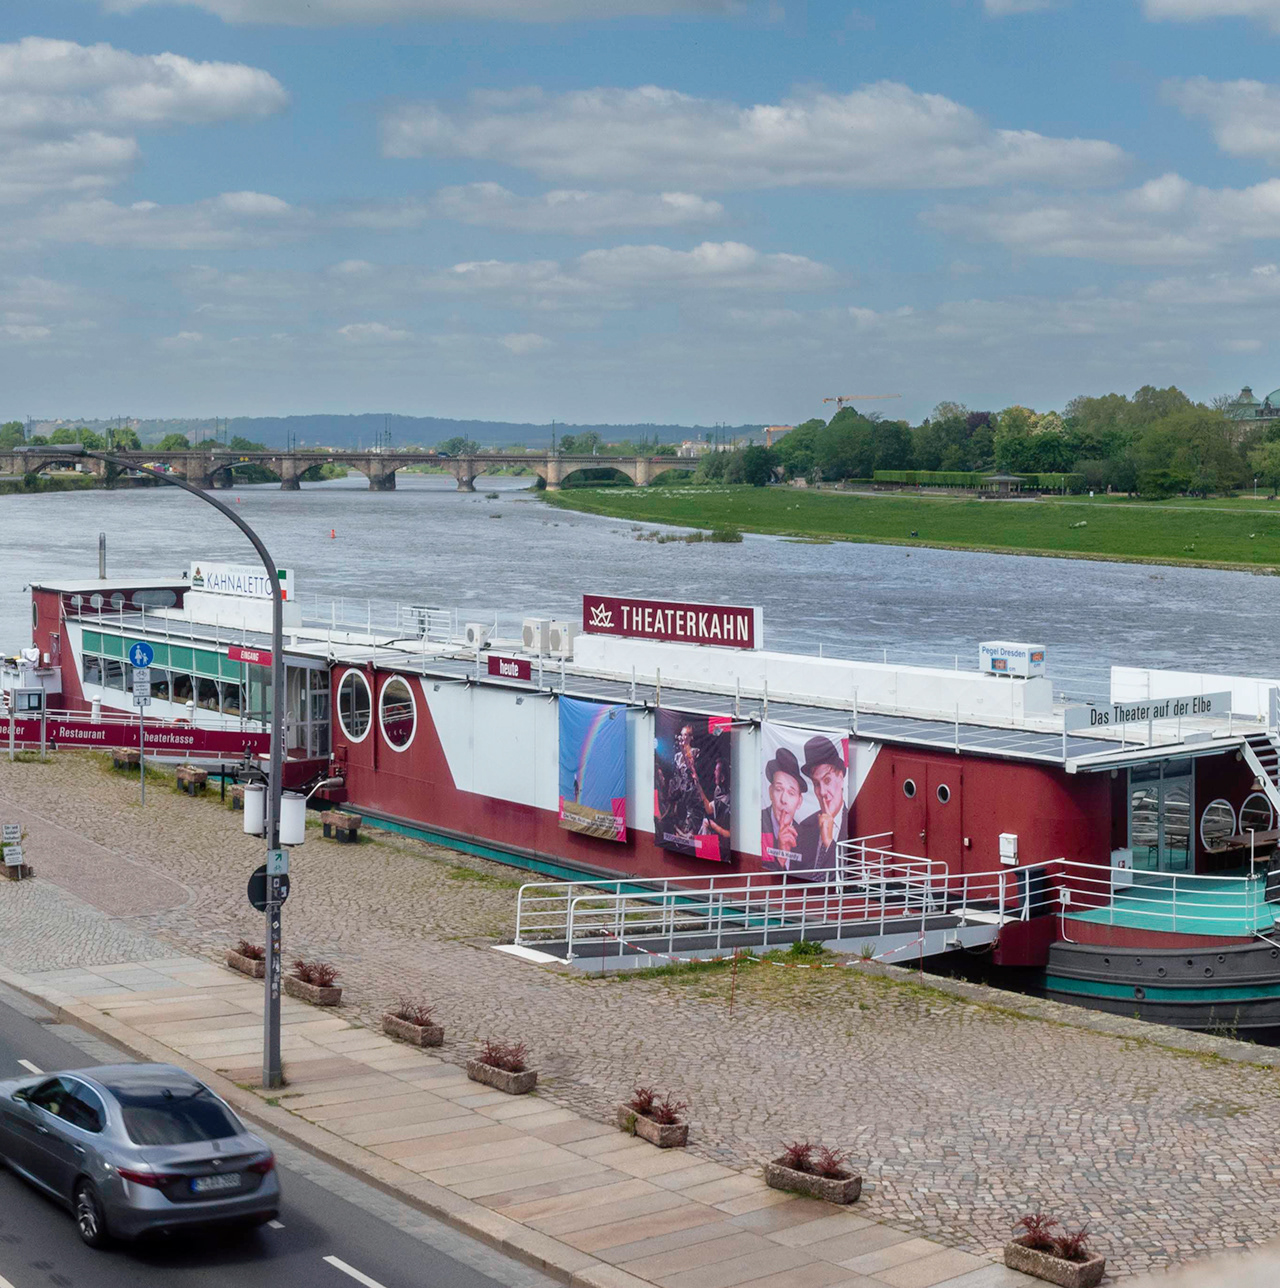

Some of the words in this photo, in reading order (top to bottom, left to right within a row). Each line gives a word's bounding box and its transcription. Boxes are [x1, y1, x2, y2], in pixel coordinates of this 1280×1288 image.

[621, 606, 749, 641] THEATERKAHN
[241, 650, 259, 661] EINGANG
[982, 646, 999, 656] Pegel
[1001, 648, 1026, 657] Dresden
[500, 659, 519, 676] heute
[1090, 708, 1109, 726] Das
[1114, 703, 1150, 722] Theater
[1153, 700, 1170, 718] auf
[1173, 699, 1189, 716] der
[1192, 697, 1211, 714] Elbe
[59, 726, 105, 739] Restaurant
